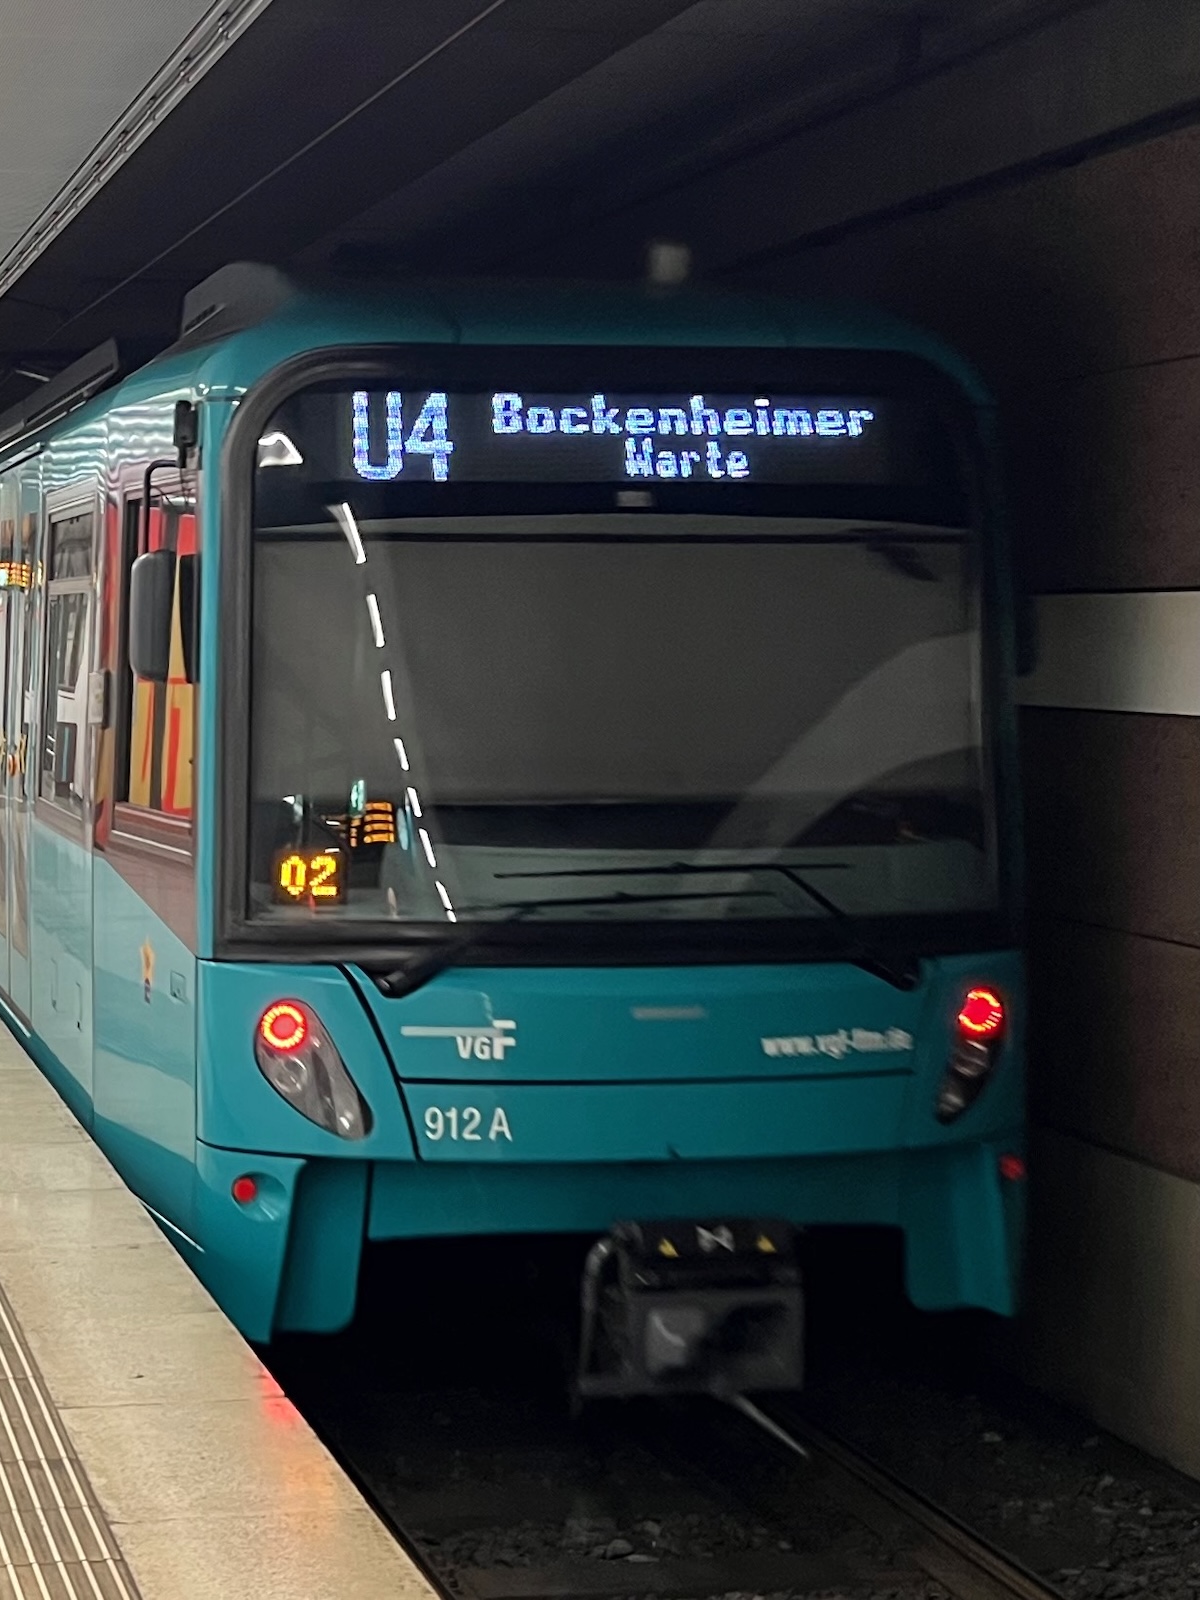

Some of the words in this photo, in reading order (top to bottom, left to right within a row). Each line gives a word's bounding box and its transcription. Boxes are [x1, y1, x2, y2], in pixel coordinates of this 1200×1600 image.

[353, 391, 455, 481] U4
[492, 392, 875, 438] Bockenheimer
[624, 437, 751, 479] Warte
[280, 855, 338, 896] 02
[455, 1019, 517, 1061] VGF
[424, 1106, 482, 1141] 912
[488, 1106, 514, 1142] A
